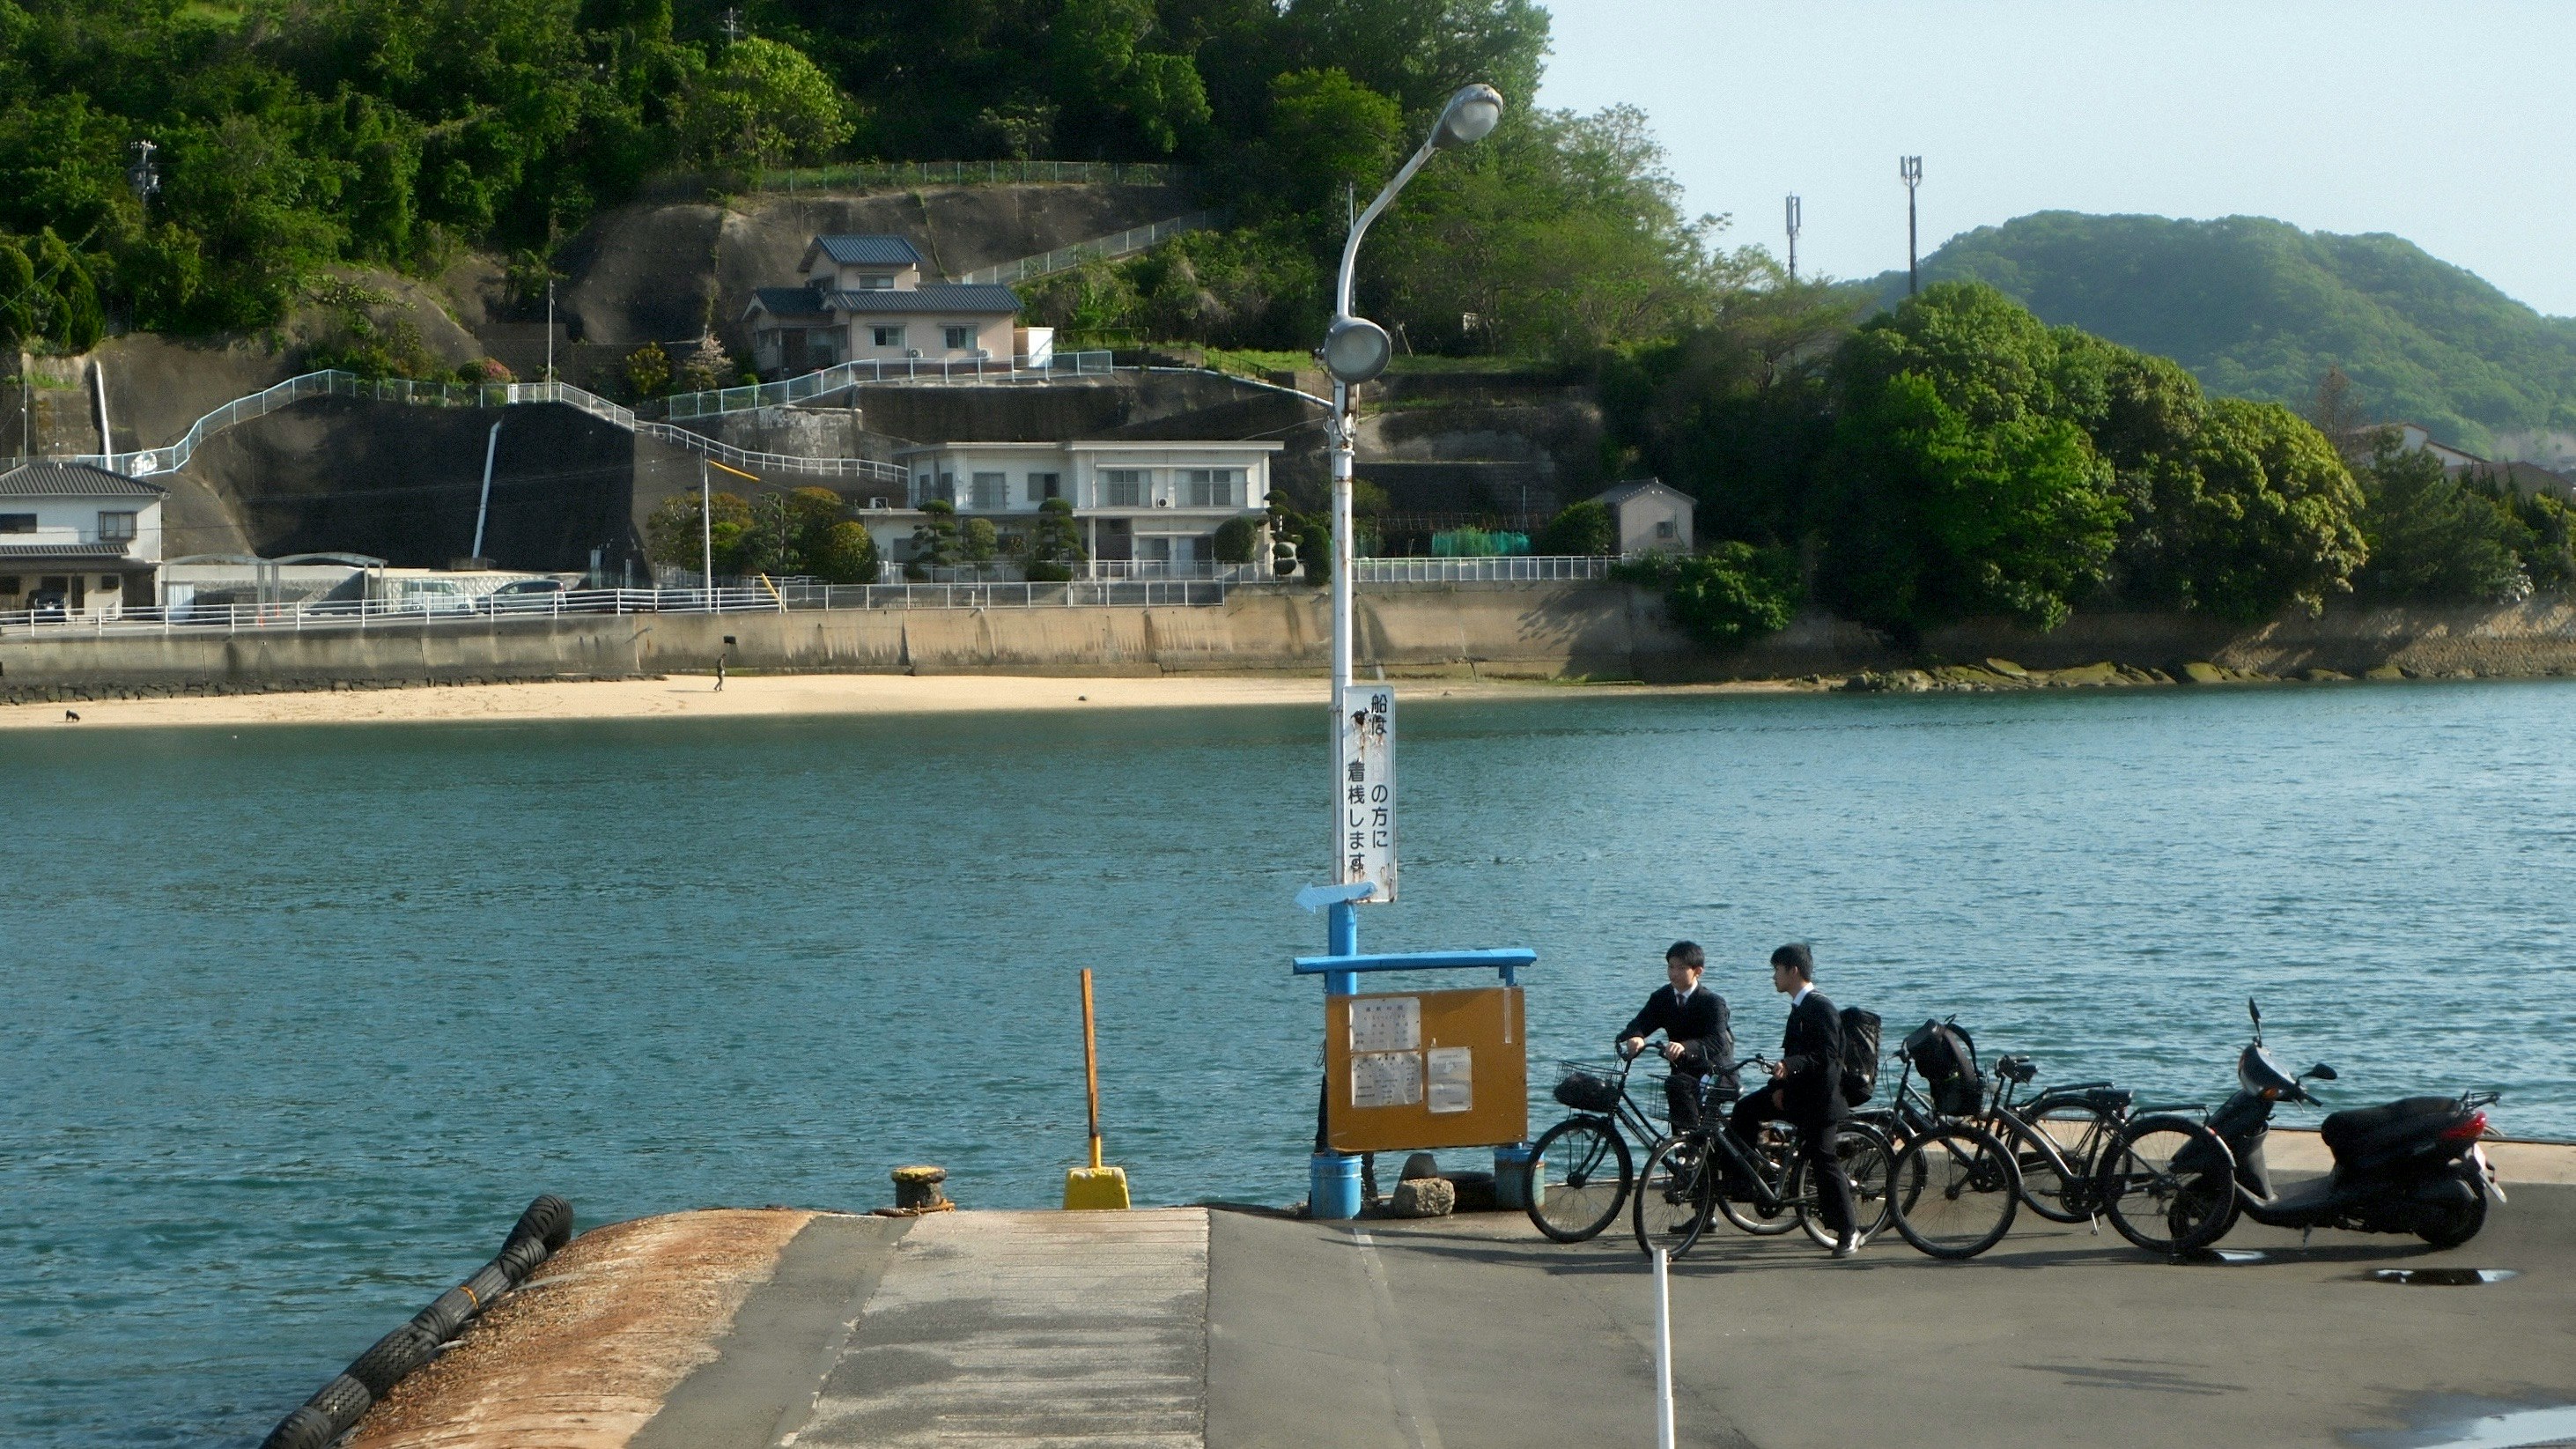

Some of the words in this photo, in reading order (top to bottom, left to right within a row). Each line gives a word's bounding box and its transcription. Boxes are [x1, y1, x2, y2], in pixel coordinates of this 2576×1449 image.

[1348, 758, 1365, 870] 着桟します
